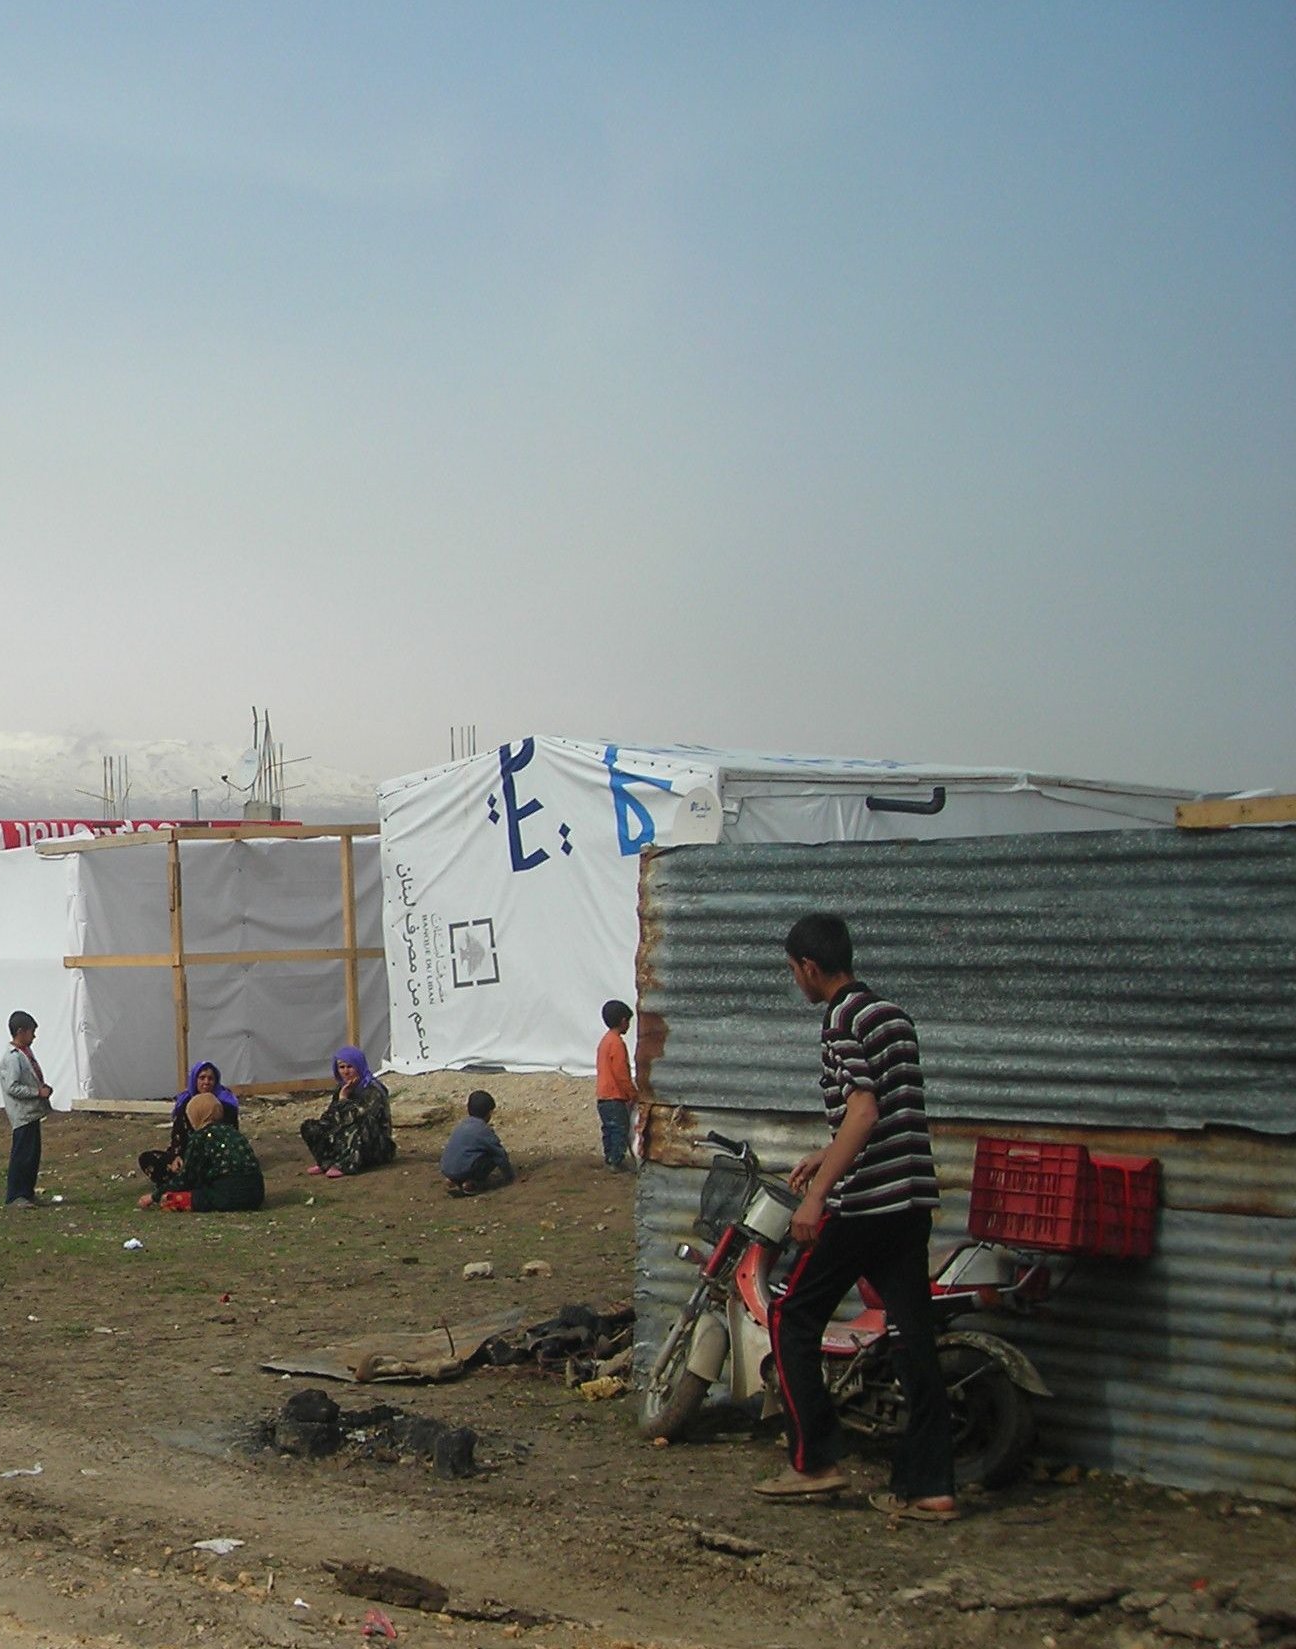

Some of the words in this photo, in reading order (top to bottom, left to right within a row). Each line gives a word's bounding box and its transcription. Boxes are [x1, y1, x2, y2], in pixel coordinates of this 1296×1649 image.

[396, 863, 416, 907] لبنان
[403, 913, 420, 974] مصرف
[407, 978, 421, 1007] من
[408, 1010, 429, 1060] بدعم
